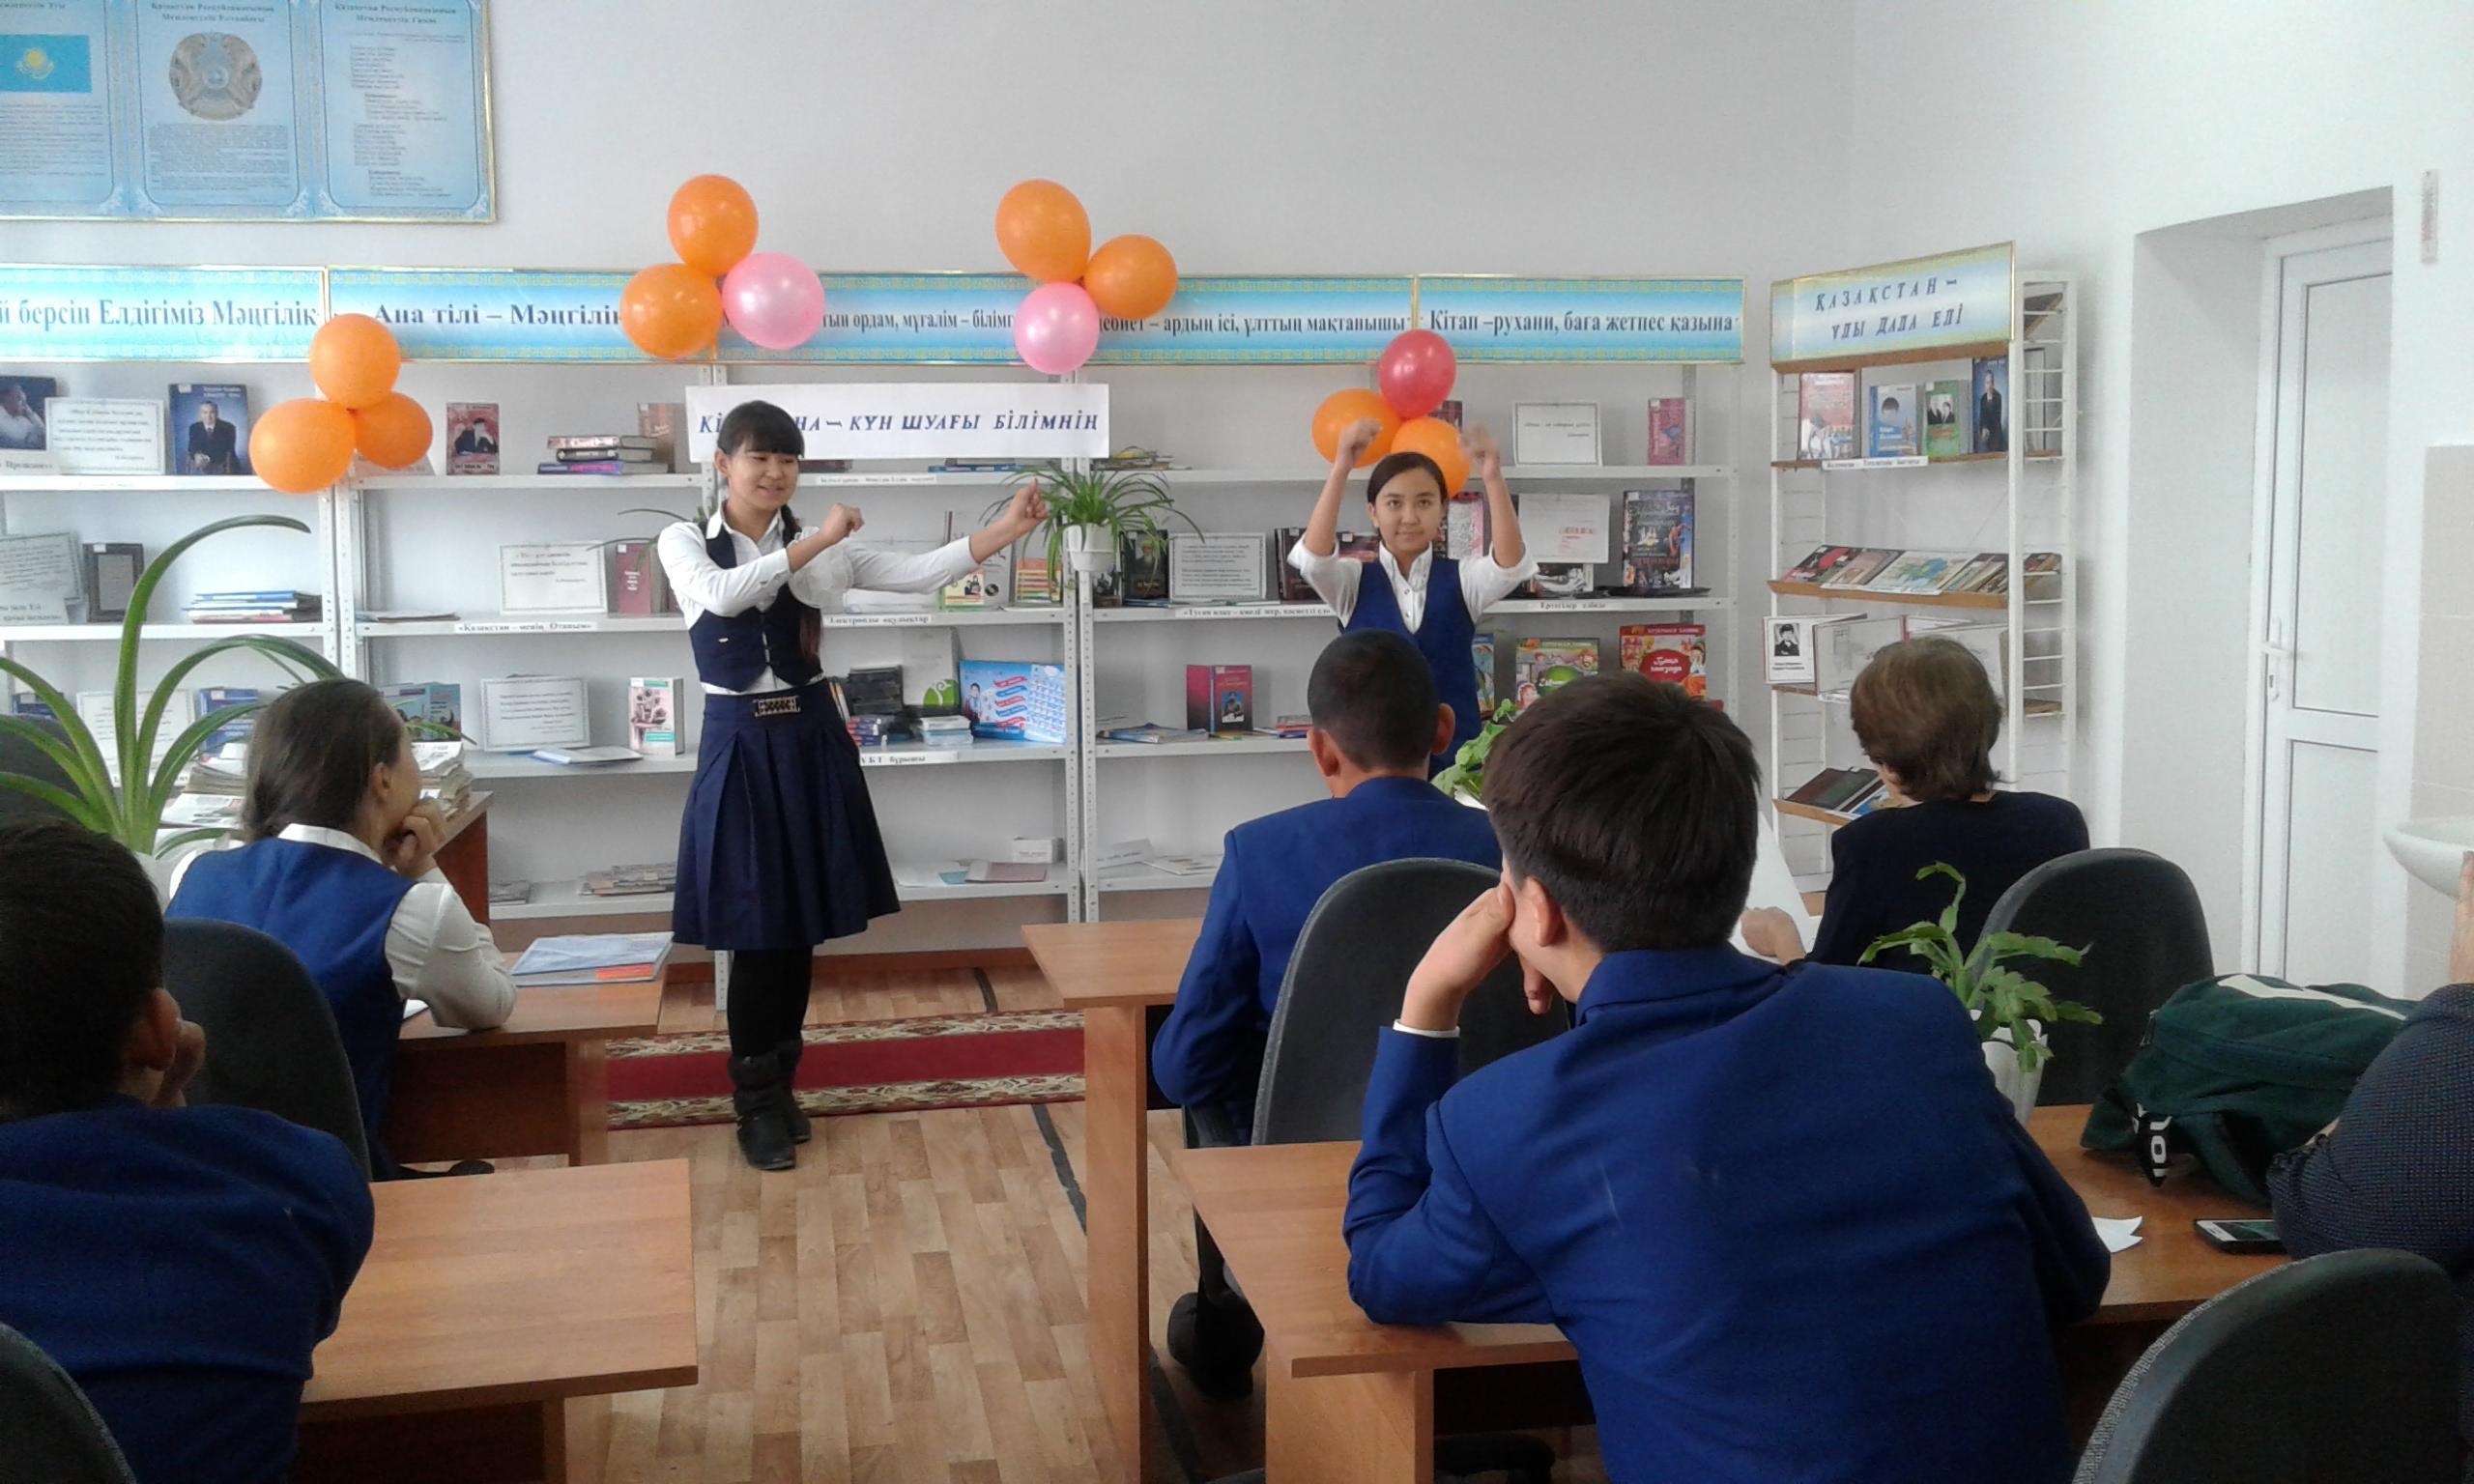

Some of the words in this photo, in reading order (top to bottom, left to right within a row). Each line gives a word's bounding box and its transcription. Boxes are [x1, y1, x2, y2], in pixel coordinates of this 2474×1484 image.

[1815, 277, 1937, 311] ҚАЗАҚСТАН
[18, 300, 90, 332] берсін
[100, 300, 205, 328] Елдігіміз
[213, 300, 318, 328] Мәңгілік
[374, 303, 424, 325] Ана
[433, 303, 480, 325] тілі
[1163, 316, 1215, 337] ардың
[1307, 316, 1406, 335] мақтанышы
[1429, 308, 1479, 332] Кітап
[1605, 316, 1665, 332] жетпес
[1670, 316, 1734, 335] қазына
[849, 414, 894, 431] КҮН
[901, 414, 982, 431] ШУАҒЫ
